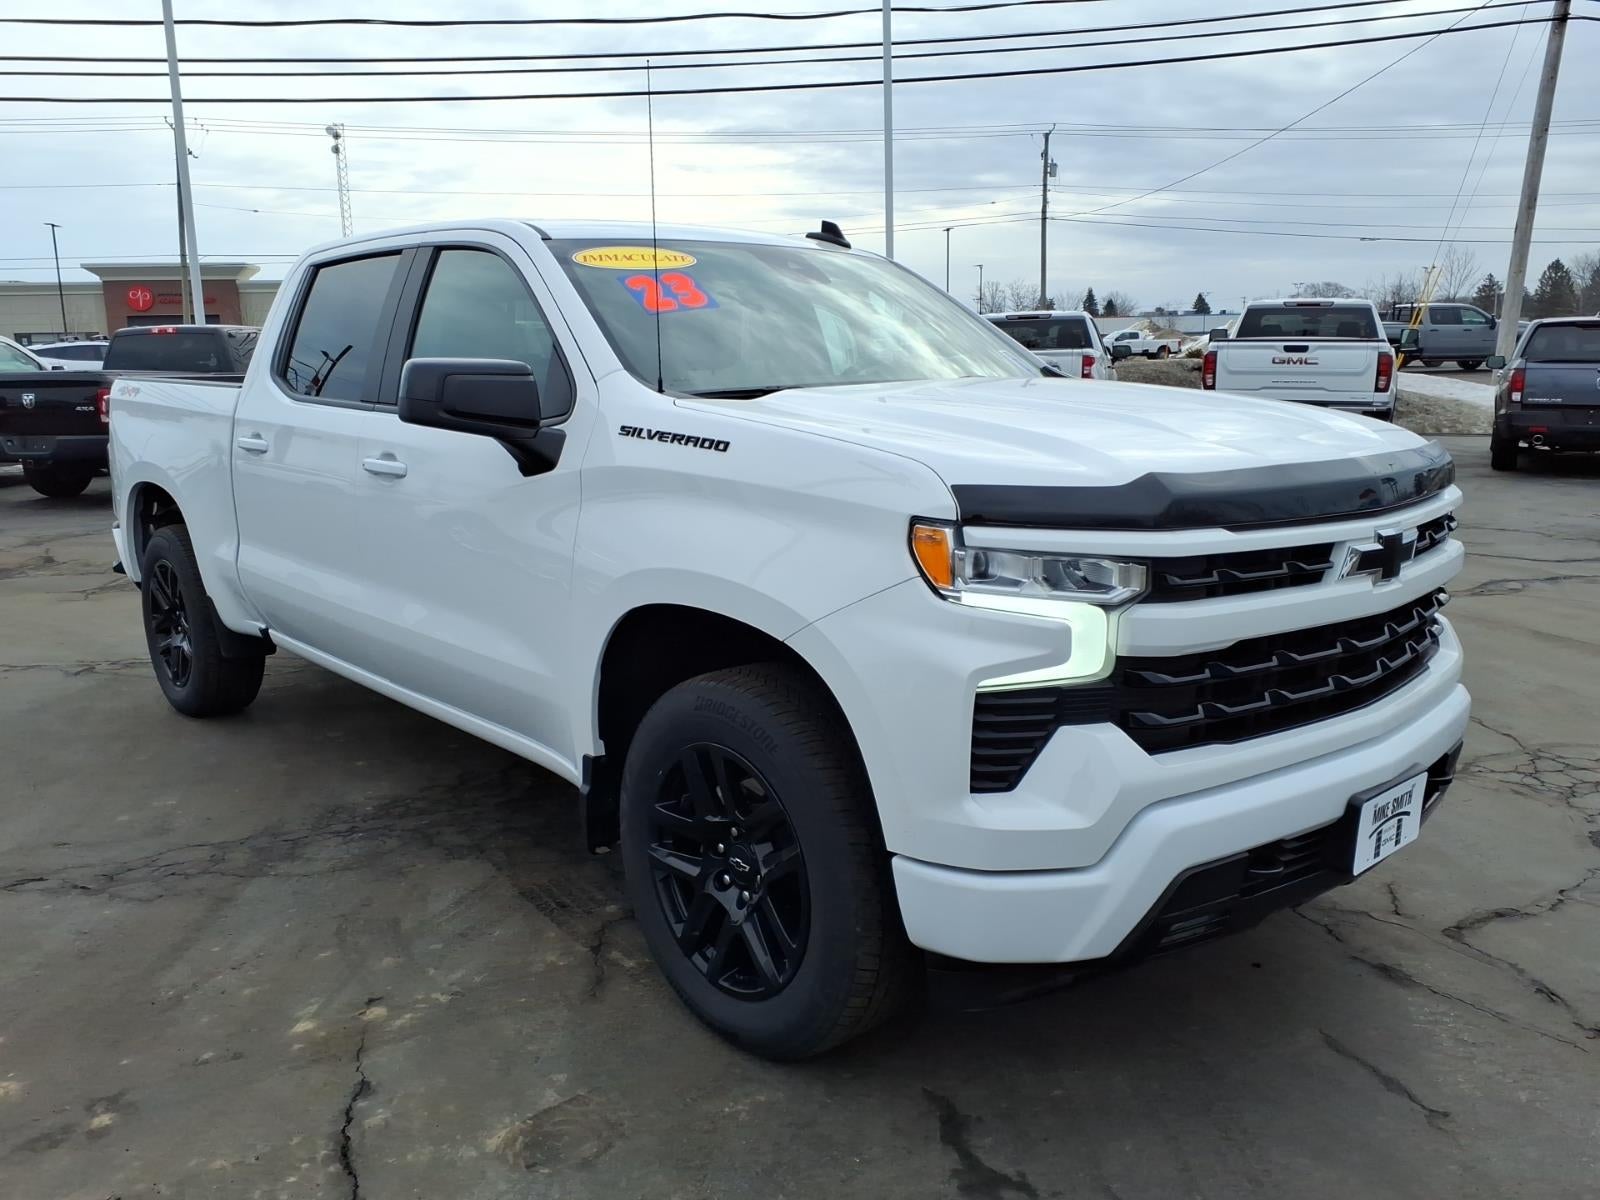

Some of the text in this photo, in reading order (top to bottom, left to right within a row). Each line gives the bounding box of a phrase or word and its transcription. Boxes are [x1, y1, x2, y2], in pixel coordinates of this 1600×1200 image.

[582, 252, 691, 263] IMMACULATE
[625, 271, 708, 313] 23
[1271, 356, 1319, 366] GMC
[618, 425, 731, 453] SILVERADO
[1372, 789, 1414, 826] MIKE SMITH
